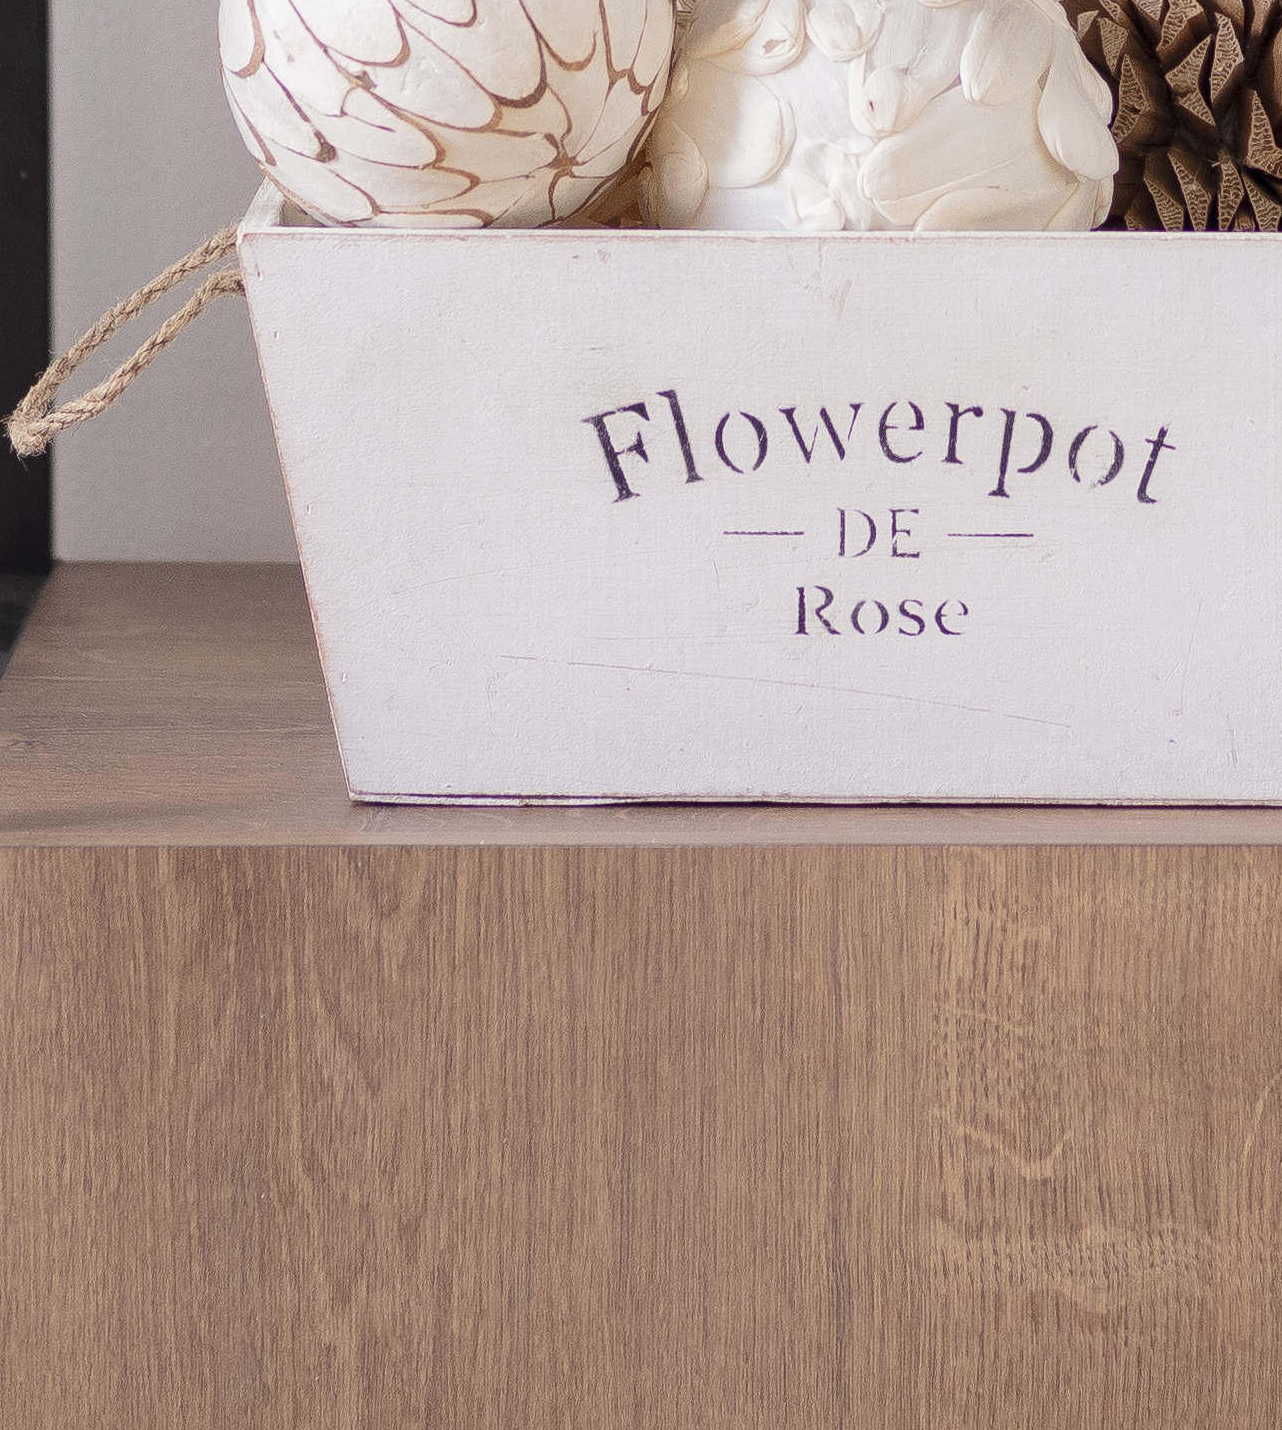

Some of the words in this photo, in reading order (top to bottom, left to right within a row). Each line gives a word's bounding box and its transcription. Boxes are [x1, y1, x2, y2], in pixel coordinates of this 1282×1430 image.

[581, 389, 1176, 505] Flowerpot
[836, 508, 921, 559] DE
[794, 585, 969, 637] Rose
